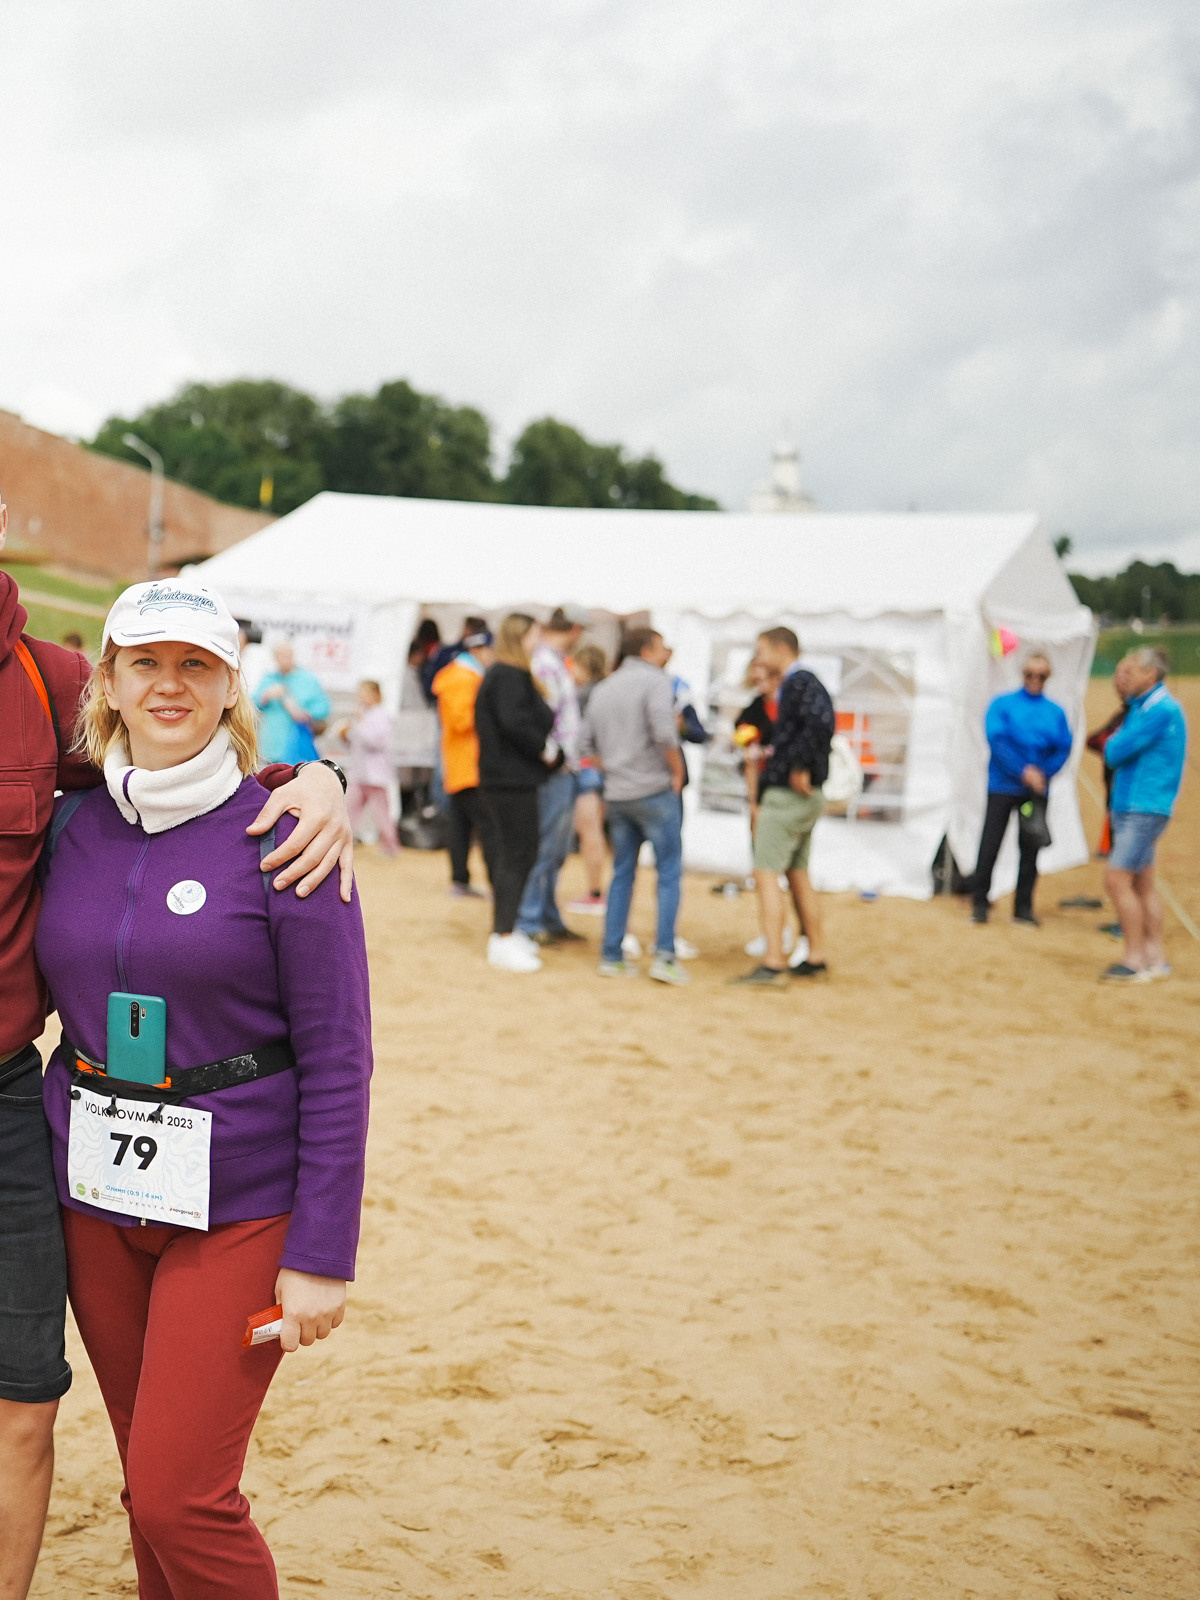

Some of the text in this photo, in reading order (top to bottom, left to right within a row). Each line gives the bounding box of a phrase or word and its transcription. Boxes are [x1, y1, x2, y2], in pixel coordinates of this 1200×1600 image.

[85, 1101, 193, 1129] VOLKOVMN 2023
[109, 1132, 158, 1171] 79
